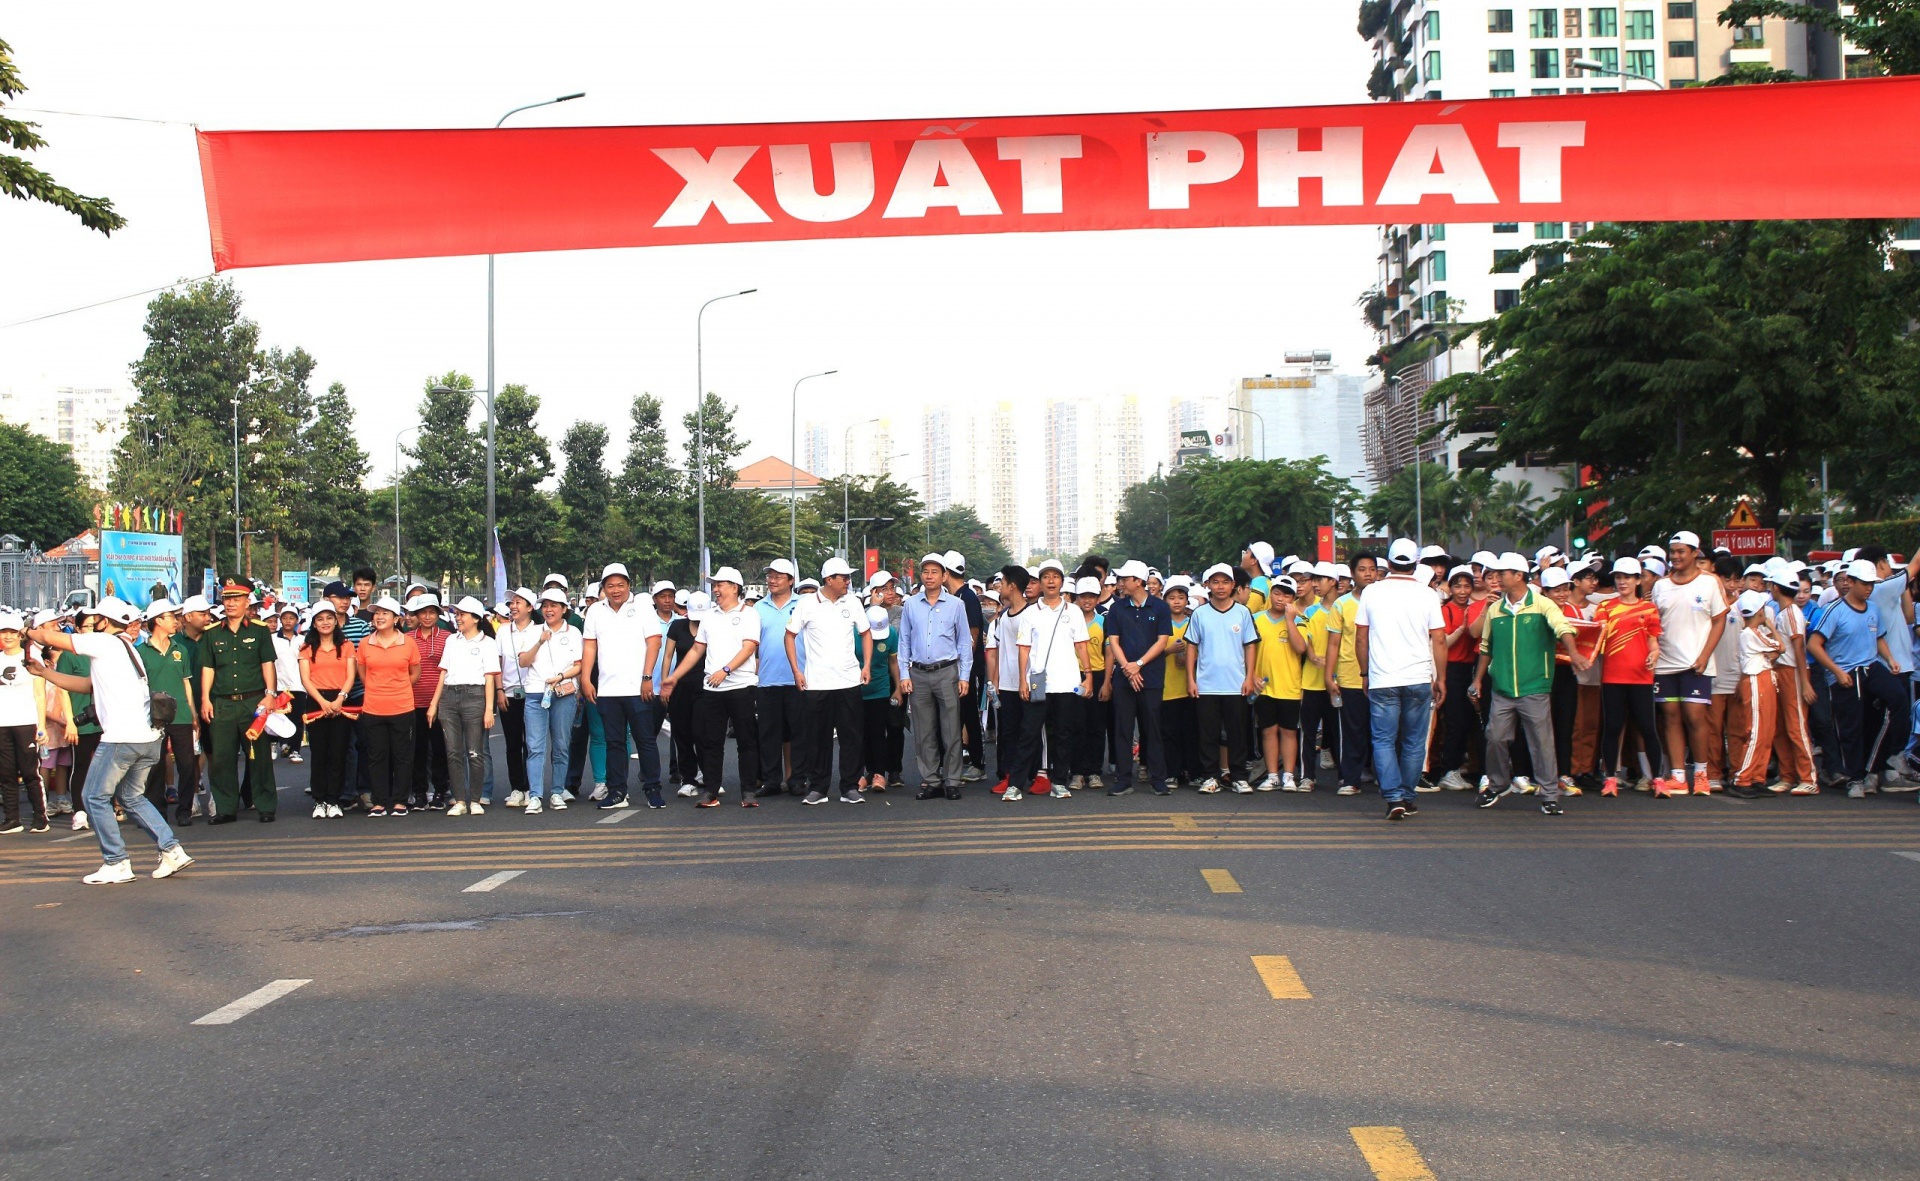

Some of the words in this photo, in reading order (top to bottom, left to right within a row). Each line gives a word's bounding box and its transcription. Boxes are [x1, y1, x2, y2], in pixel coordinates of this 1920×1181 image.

[649, 121, 1083, 227] XUẤT
[1147, 104, 1586, 210] PHÁT
[1715, 533, 1729, 548] CHÚ
[1731, 533, 1736, 549] Ý
[1737, 536, 1756, 549] QUAN
[1757, 532, 1772, 548] SÁT
